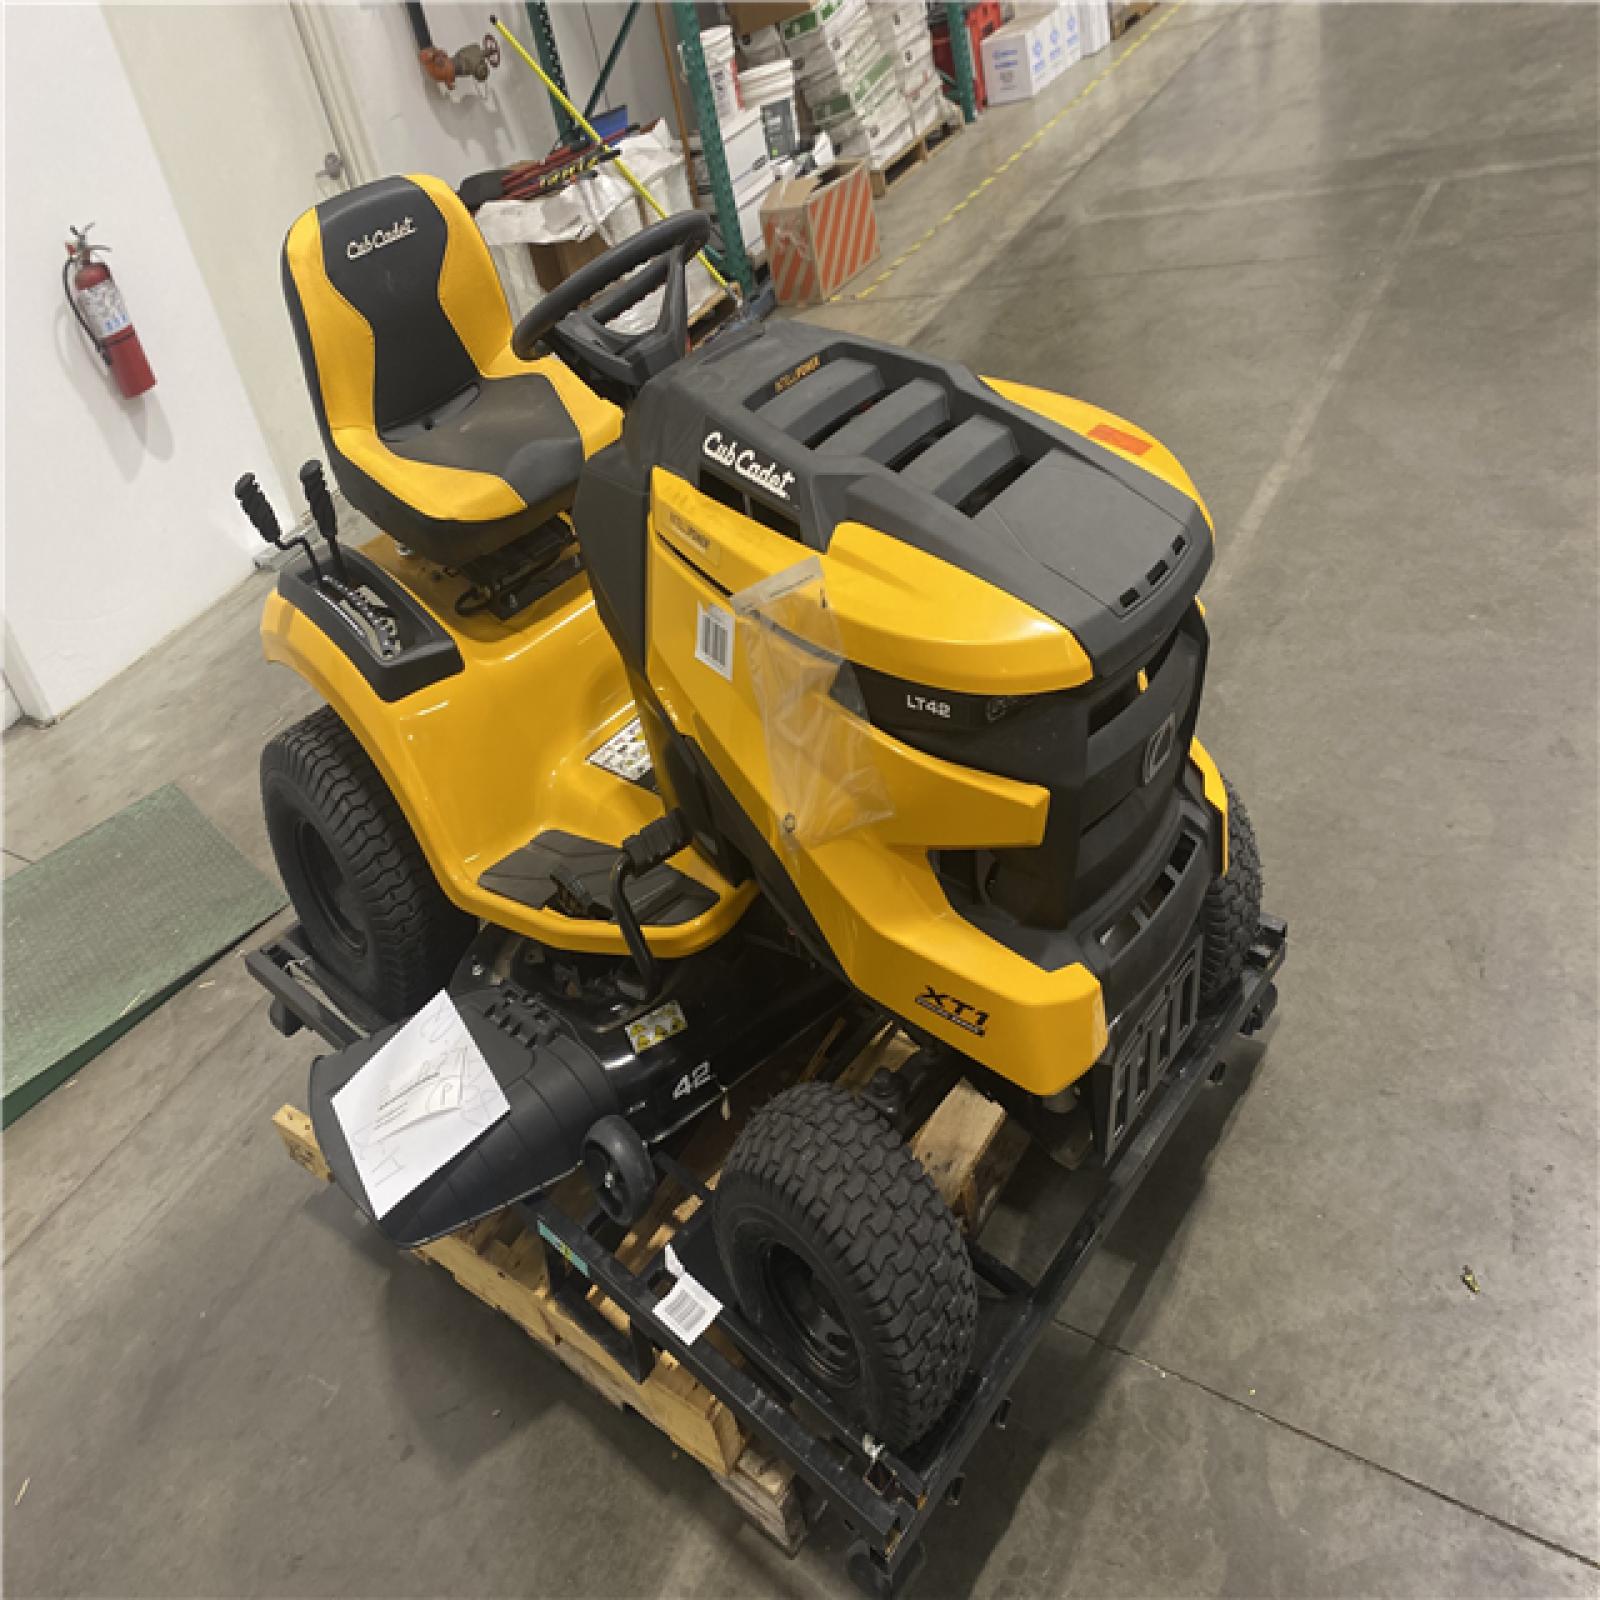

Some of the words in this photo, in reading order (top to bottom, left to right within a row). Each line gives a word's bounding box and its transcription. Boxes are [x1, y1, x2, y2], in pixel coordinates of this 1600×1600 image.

[346, 233, 373, 260] Cub
[373, 215, 417, 248] Cadet
[703, 432, 737, 467] Cub
[735, 450, 795, 500] Cadet
[906, 694, 951, 719] LT42
[918, 985, 989, 1026] XT1
[672, 1061, 711, 1100] 42
